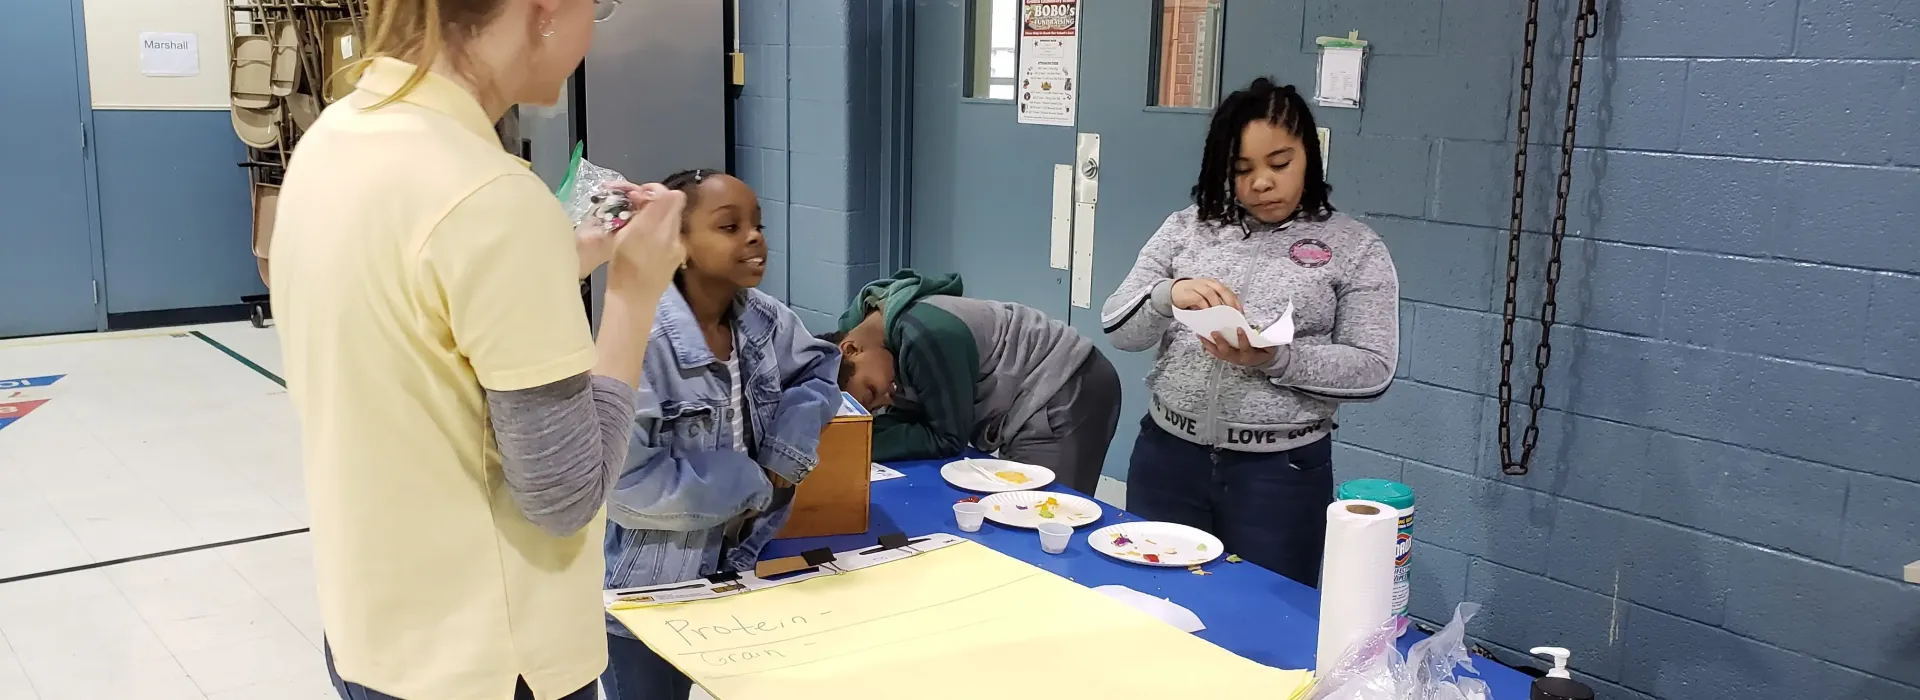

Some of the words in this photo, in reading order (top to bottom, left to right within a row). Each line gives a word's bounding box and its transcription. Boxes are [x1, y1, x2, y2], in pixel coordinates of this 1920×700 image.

[1034, 4, 1075, 17] BOBO's
[1034, 18, 1075, 26] FUNDRAISING
[144, 39, 188, 50] Marshall
[1164, 405, 1197, 436] LOVE
[1227, 428, 1276, 444] LOVE
[664, 615, 808, 647] Protein
[700, 648, 787, 667] Grain
